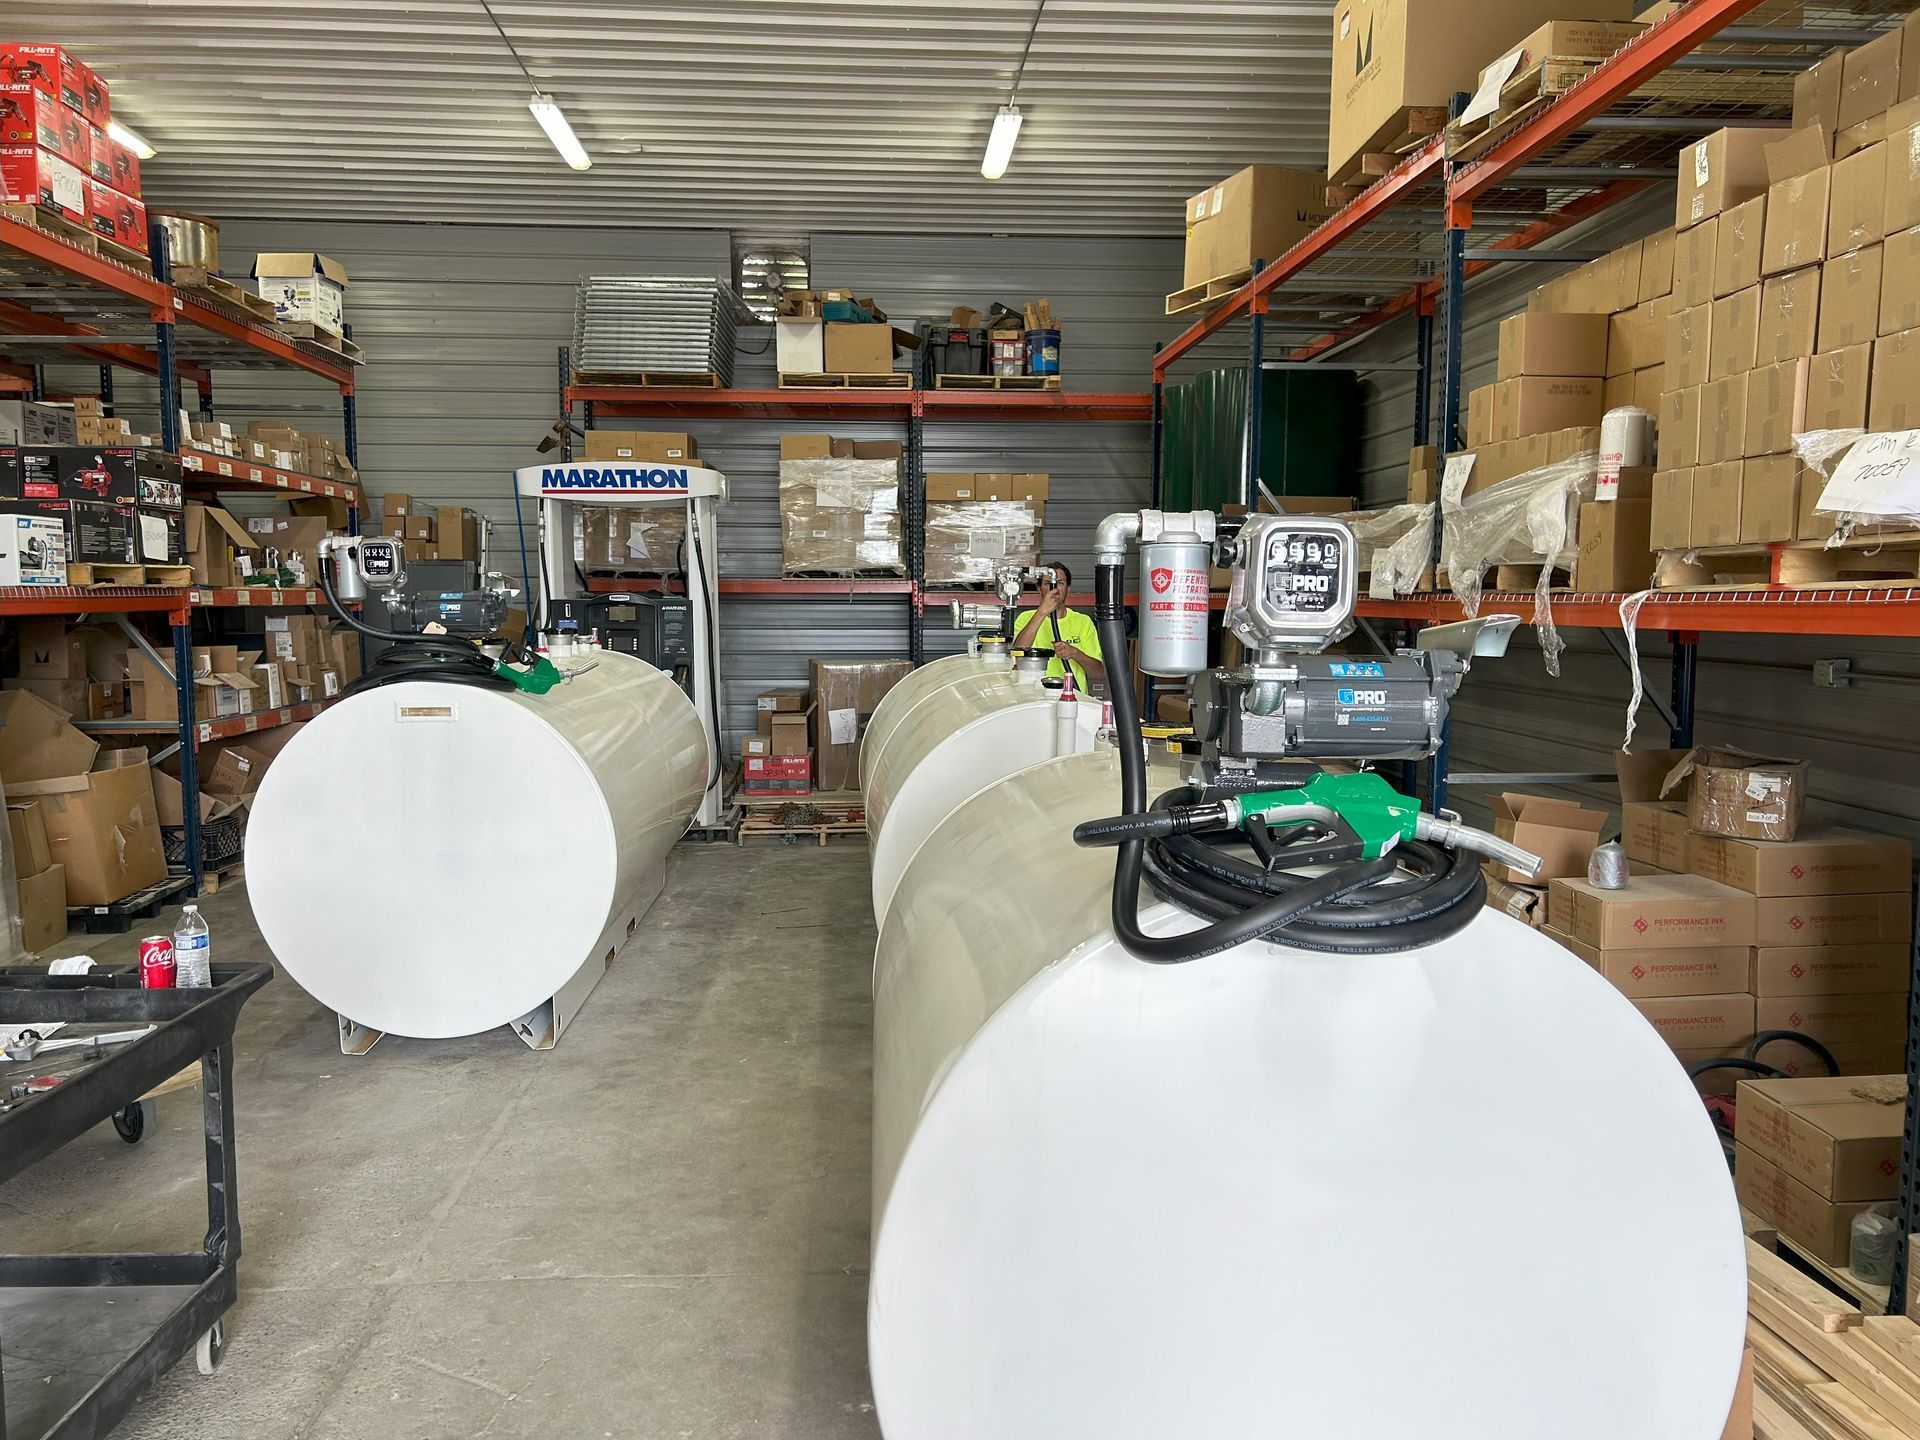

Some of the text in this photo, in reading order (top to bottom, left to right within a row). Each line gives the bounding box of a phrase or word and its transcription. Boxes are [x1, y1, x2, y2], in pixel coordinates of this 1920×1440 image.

[541, 469, 689, 488] MARATHON
[1110, 823, 1134, 832] VAPOR
[1654, 917, 1710, 926] PERFORMANCE
[1200, 944, 1223, 955] MADE
[1651, 963, 1704, 973] PERFORMANCE
[1654, 1016, 1709, 1026] PERFORMANCE
